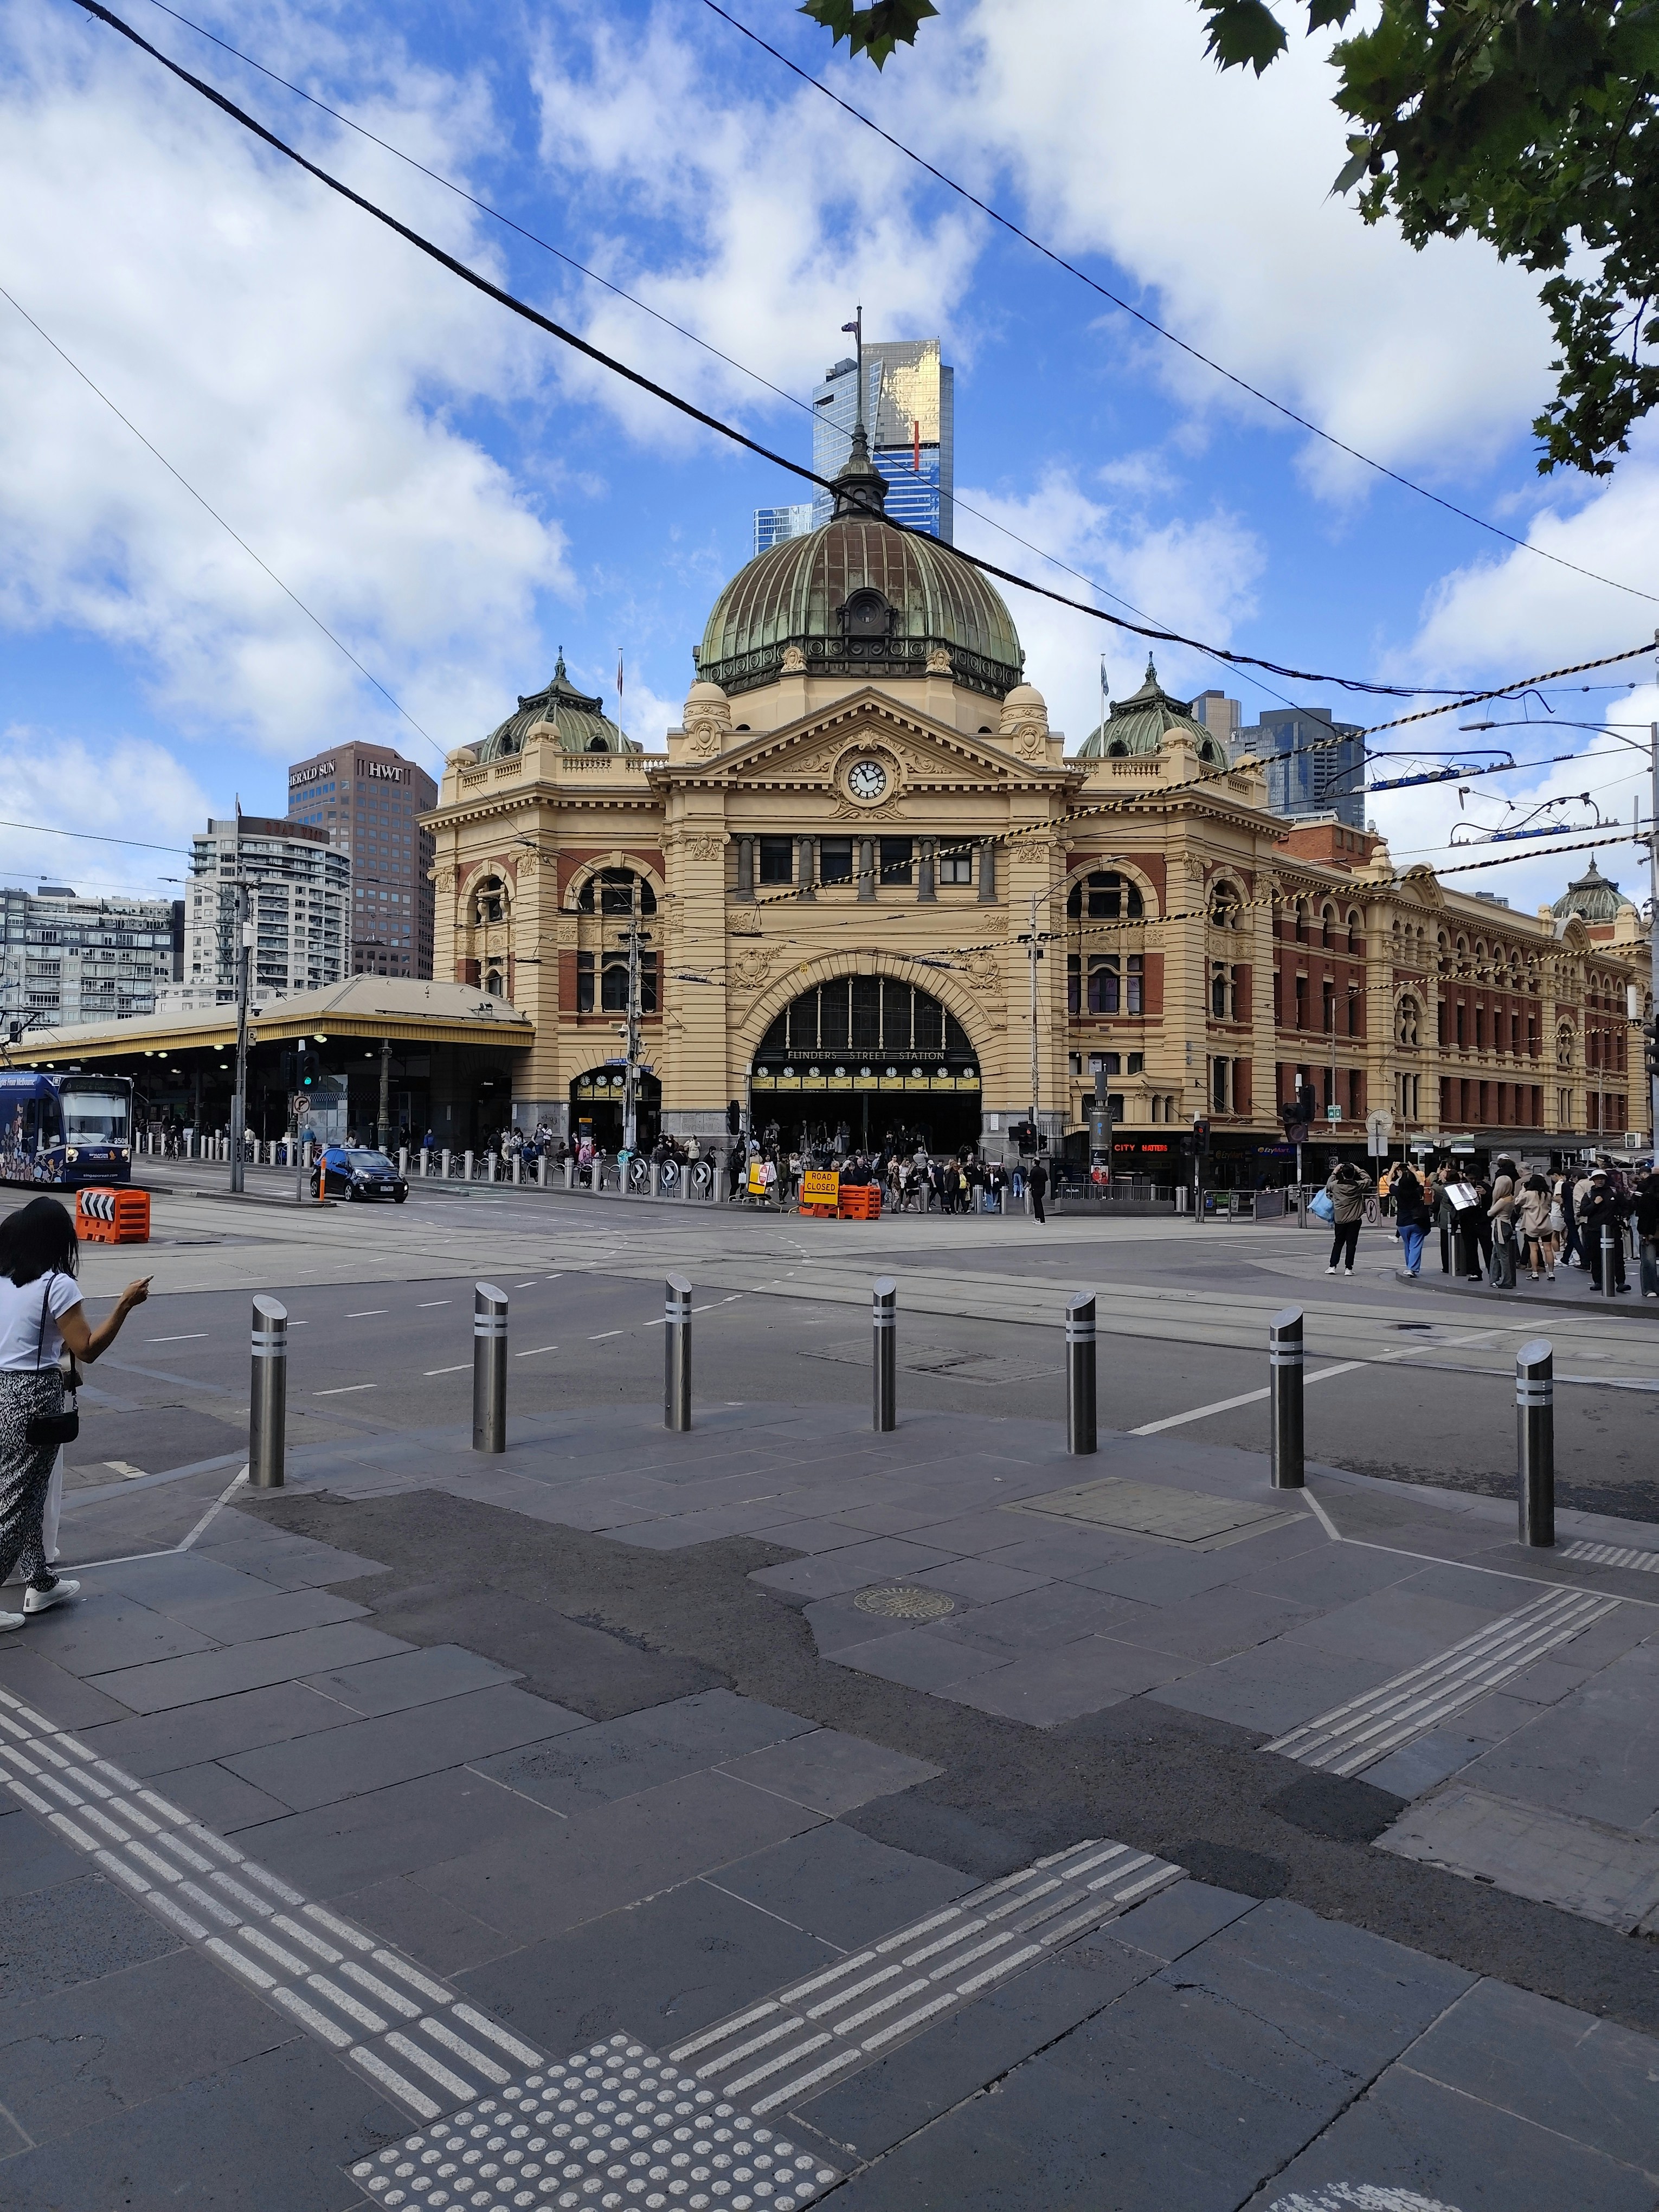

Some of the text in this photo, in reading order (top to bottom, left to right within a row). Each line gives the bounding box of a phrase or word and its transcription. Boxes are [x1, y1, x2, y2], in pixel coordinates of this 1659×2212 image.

[288, 760, 336, 786] HERALD SUN
[369, 762, 403, 781] HWT
[788, 1051, 944, 1060] FLINDERS STREET STATION
[7, 1077, 16, 1086] From
[16, 1077, 35, 1086] Melbourne
[807, 1182, 835, 1191] CLOSED
